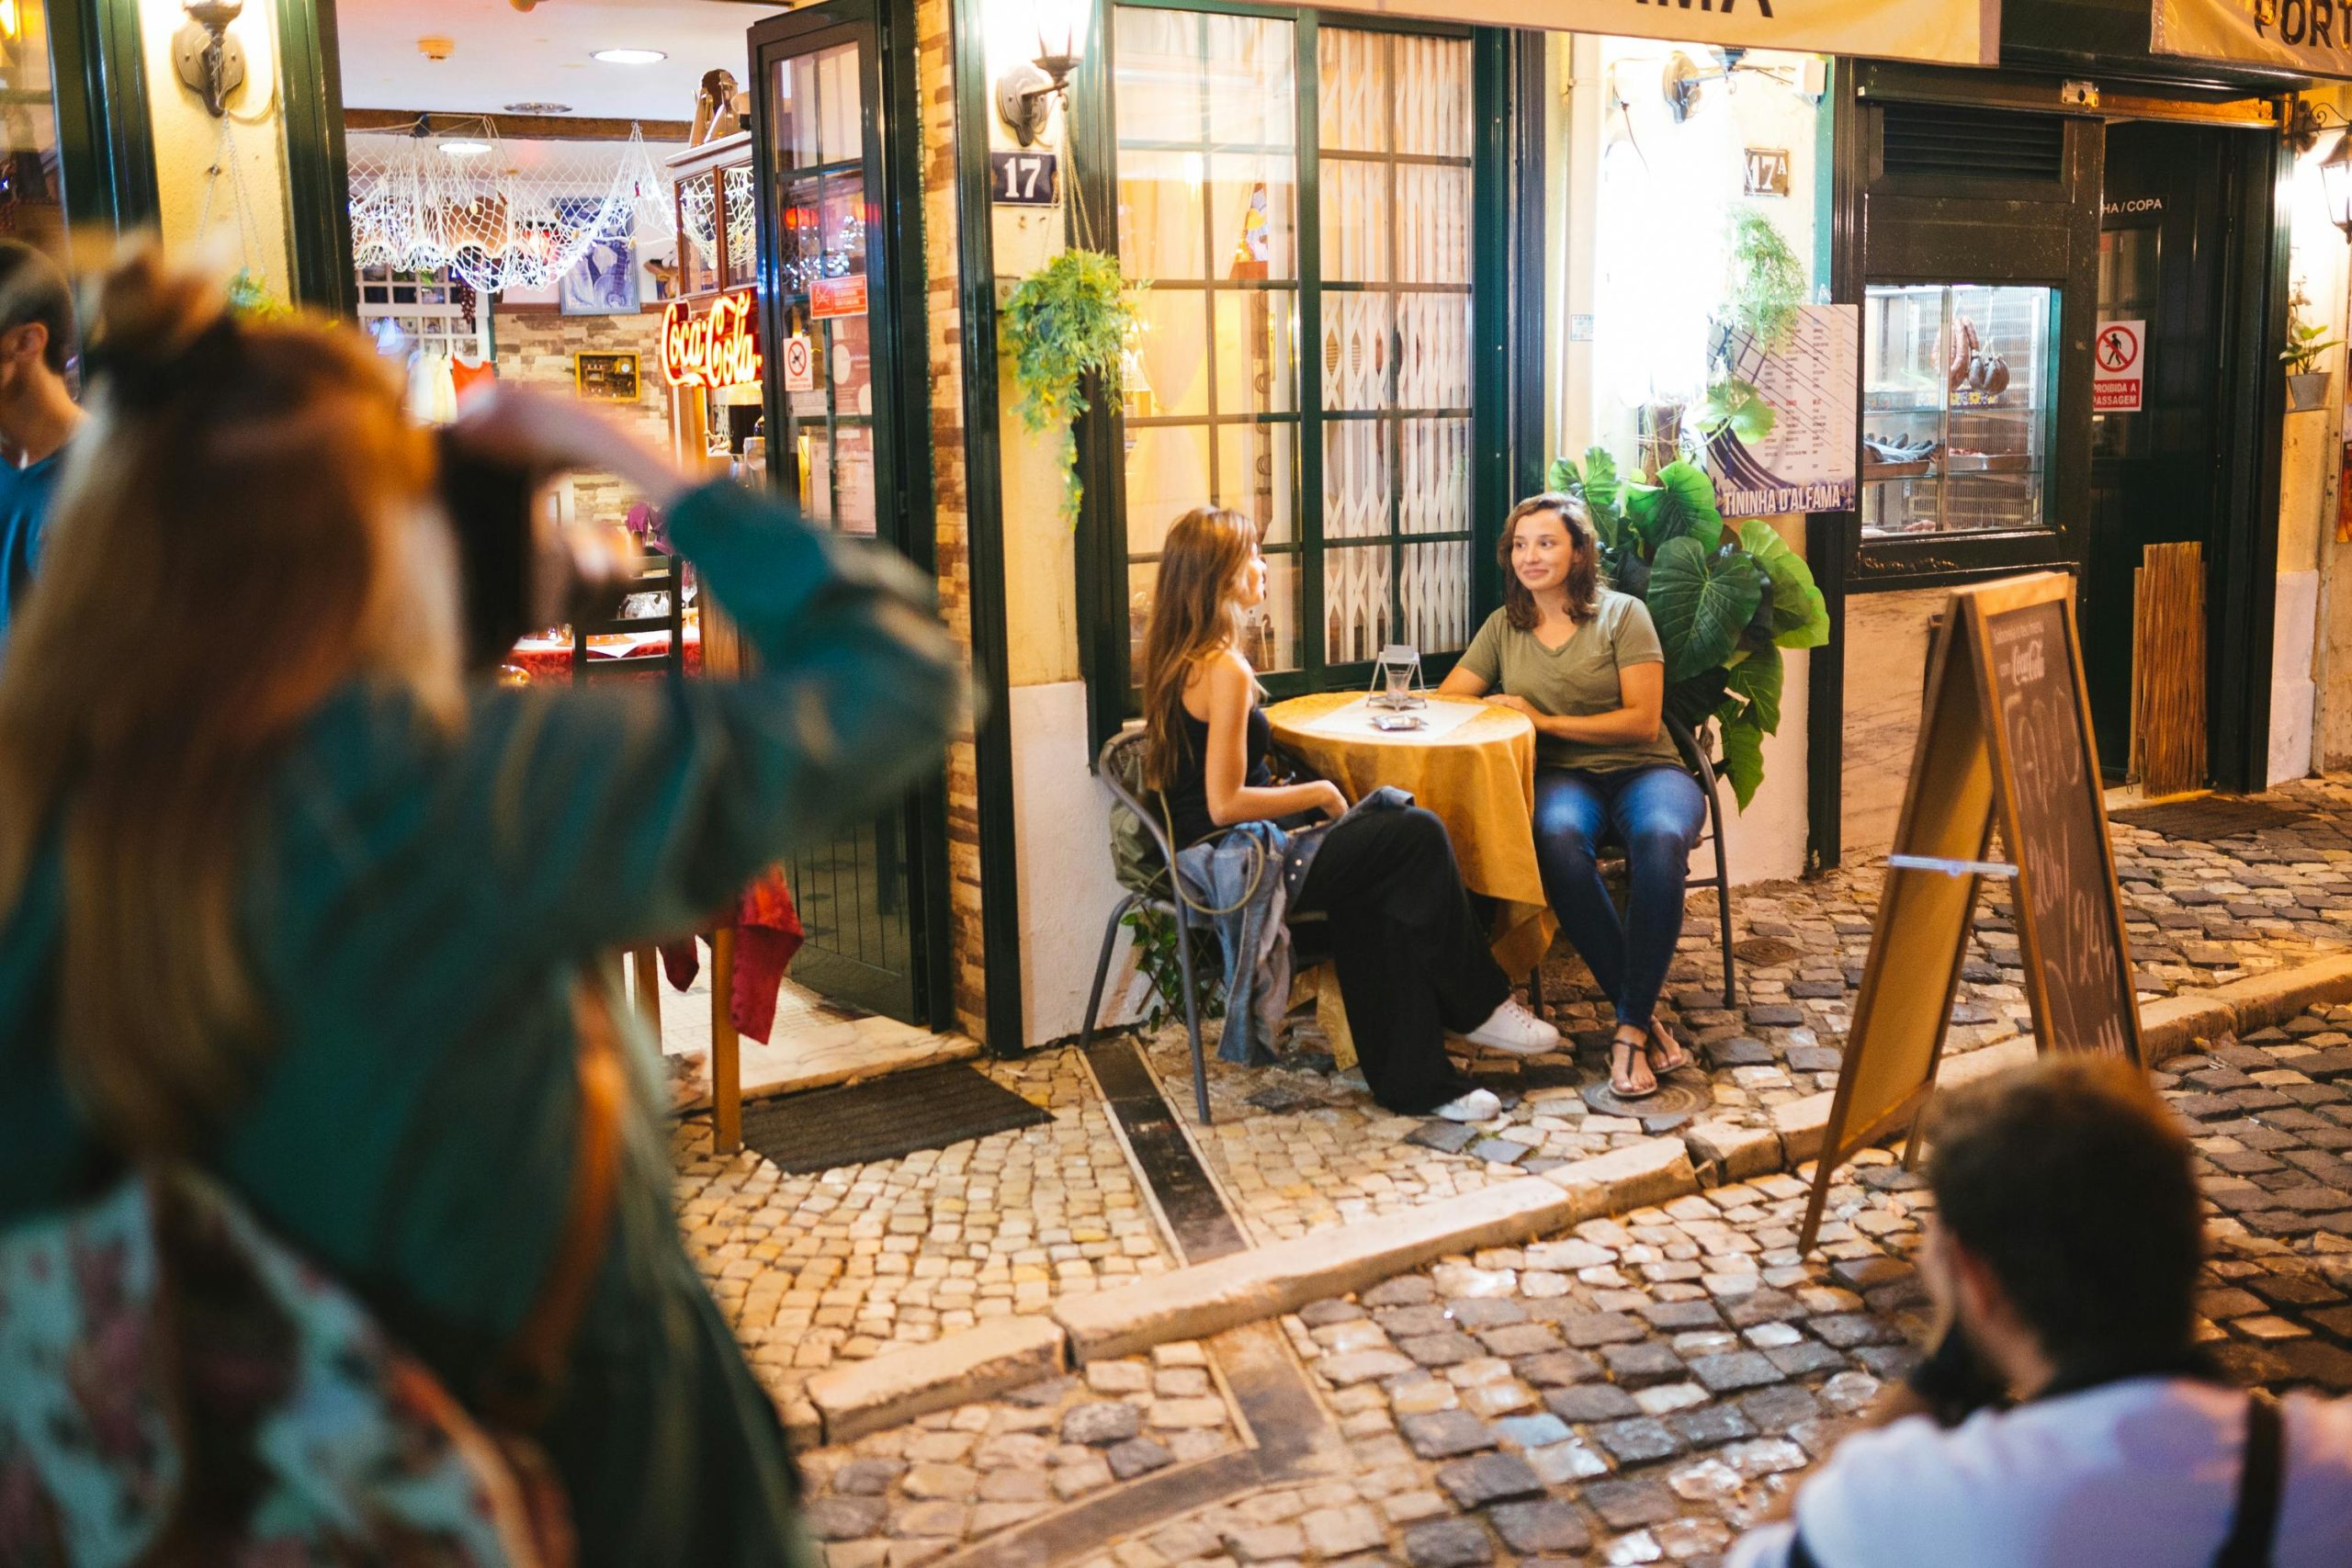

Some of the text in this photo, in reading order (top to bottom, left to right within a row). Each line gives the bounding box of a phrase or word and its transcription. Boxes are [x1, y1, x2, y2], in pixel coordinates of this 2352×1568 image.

[1004, 157, 1041, 198] 17
[2094, 382, 2137, 393] PROIBIDA A
[1723, 485, 1841, 515] TININHA D'ALFAMA
